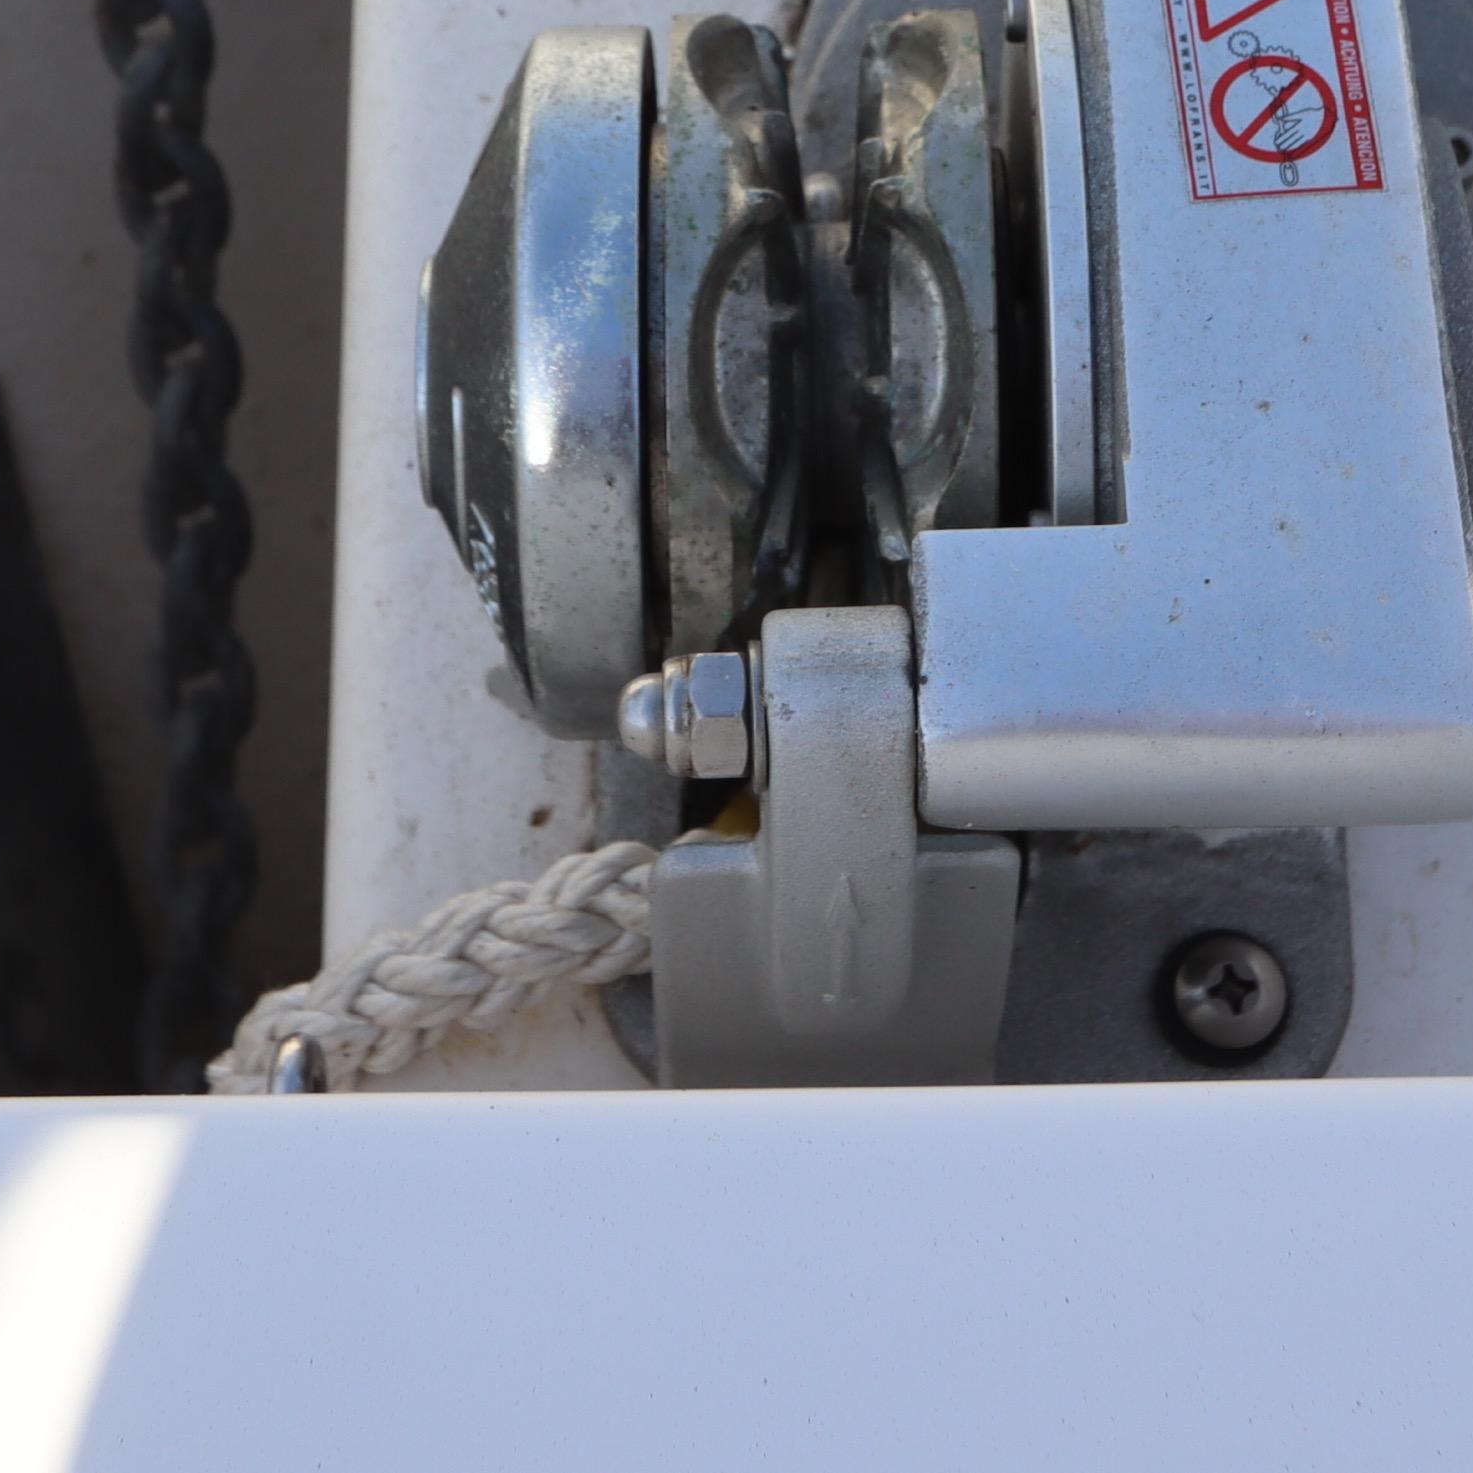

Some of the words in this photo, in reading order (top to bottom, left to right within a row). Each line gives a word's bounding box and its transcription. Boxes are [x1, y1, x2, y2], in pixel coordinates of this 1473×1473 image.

[1179, 33, 1210, 190] WWW.LOFRANS.IT
[1340, 39, 1364, 101] ACHTUNG
[1354, 116, 1377, 181] ATENCION
